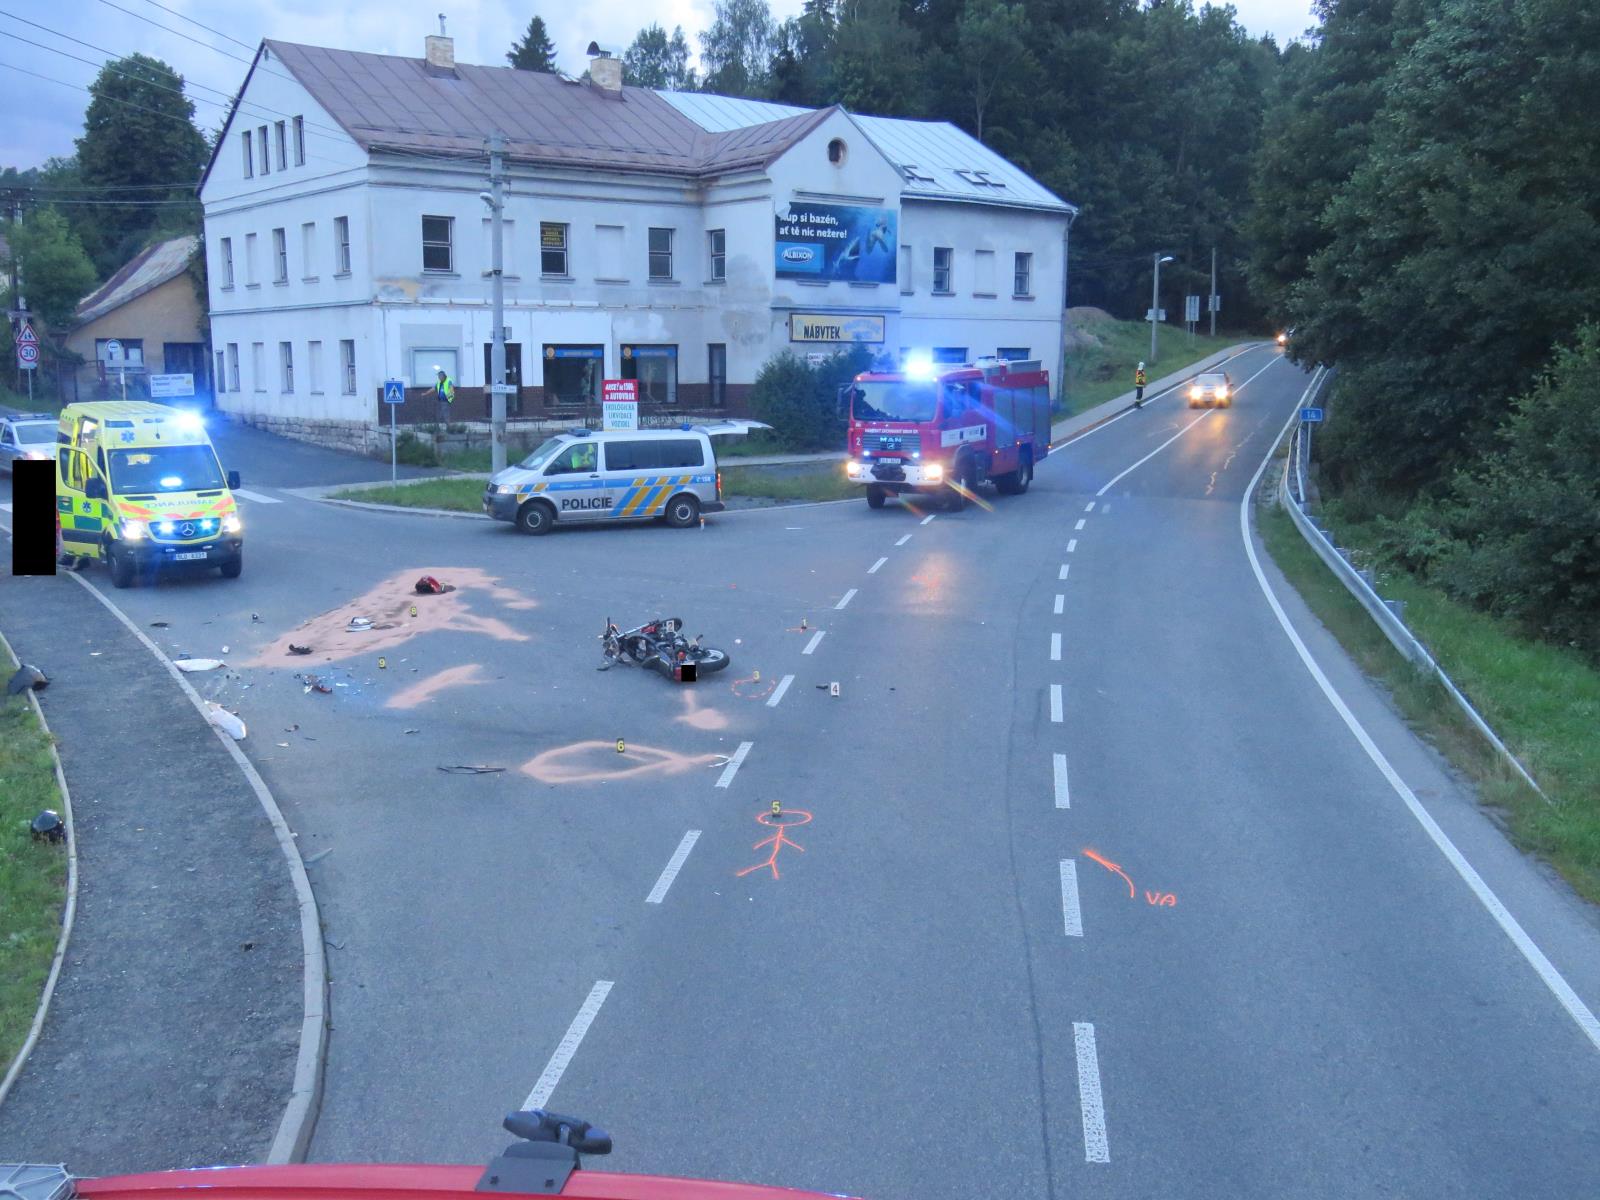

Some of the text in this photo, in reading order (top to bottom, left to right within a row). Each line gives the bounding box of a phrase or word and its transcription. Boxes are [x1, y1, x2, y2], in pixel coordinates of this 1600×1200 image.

[800, 213, 808, 222] si
[809, 213, 839, 225] bazén,
[790, 226, 800, 236] tě
[801, 226, 815, 237] nic
[816, 227, 847, 239] nežere!
[783, 249, 812, 260] ALBIXON
[803, 323, 840, 339] NÁBYTEK
[24, 348, 34, 358] 30
[1307, 411, 1317, 419] 14
[856, 438, 861, 446] 2
[561, 497, 613, 510] POLICIE
[379, 658, 386, 668] 9
[832, 684, 839, 694] 4
[617, 740, 625, 752] 6
[772, 801, 781, 814] 5
